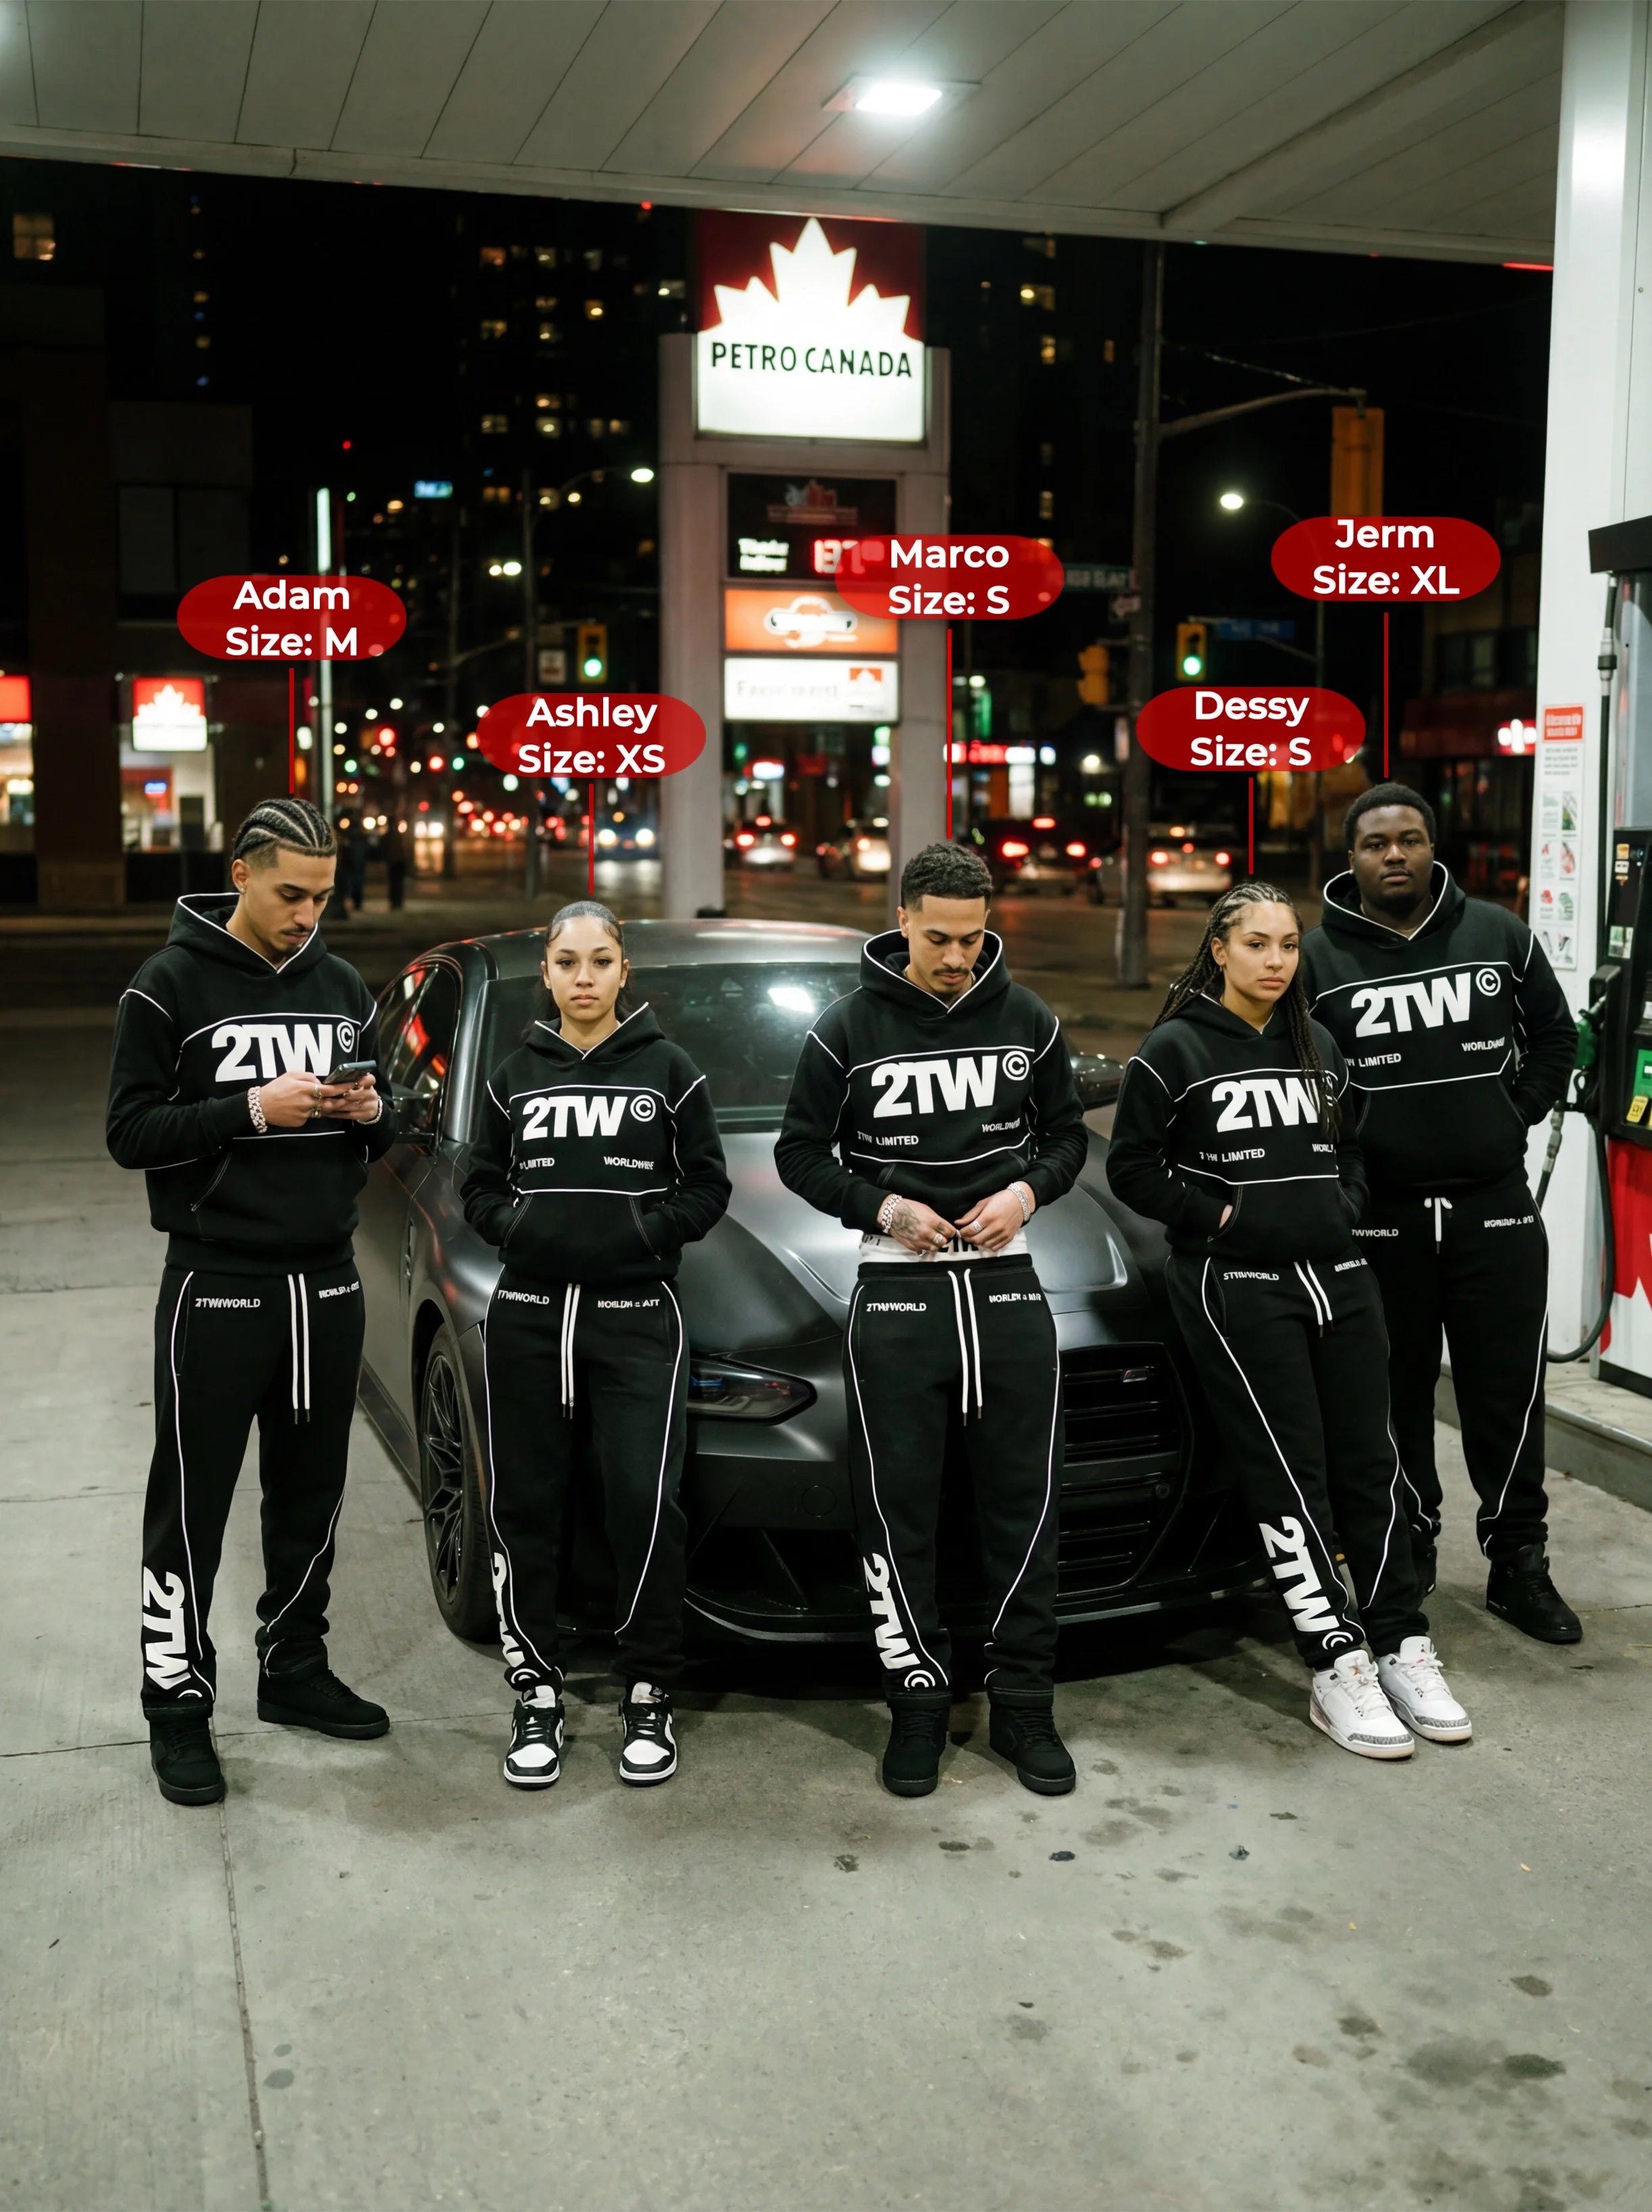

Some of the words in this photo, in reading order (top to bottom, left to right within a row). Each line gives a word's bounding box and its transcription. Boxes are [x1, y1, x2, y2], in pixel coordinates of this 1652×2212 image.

[711, 342, 797, 371] PETRO
[805, 347, 912, 379] CANADA
[1358, 1052, 1402, 1068] LIMITED
[875, 1135, 920, 1146] LIMITED
[1221, 1148, 1266, 1163] LIMITED
